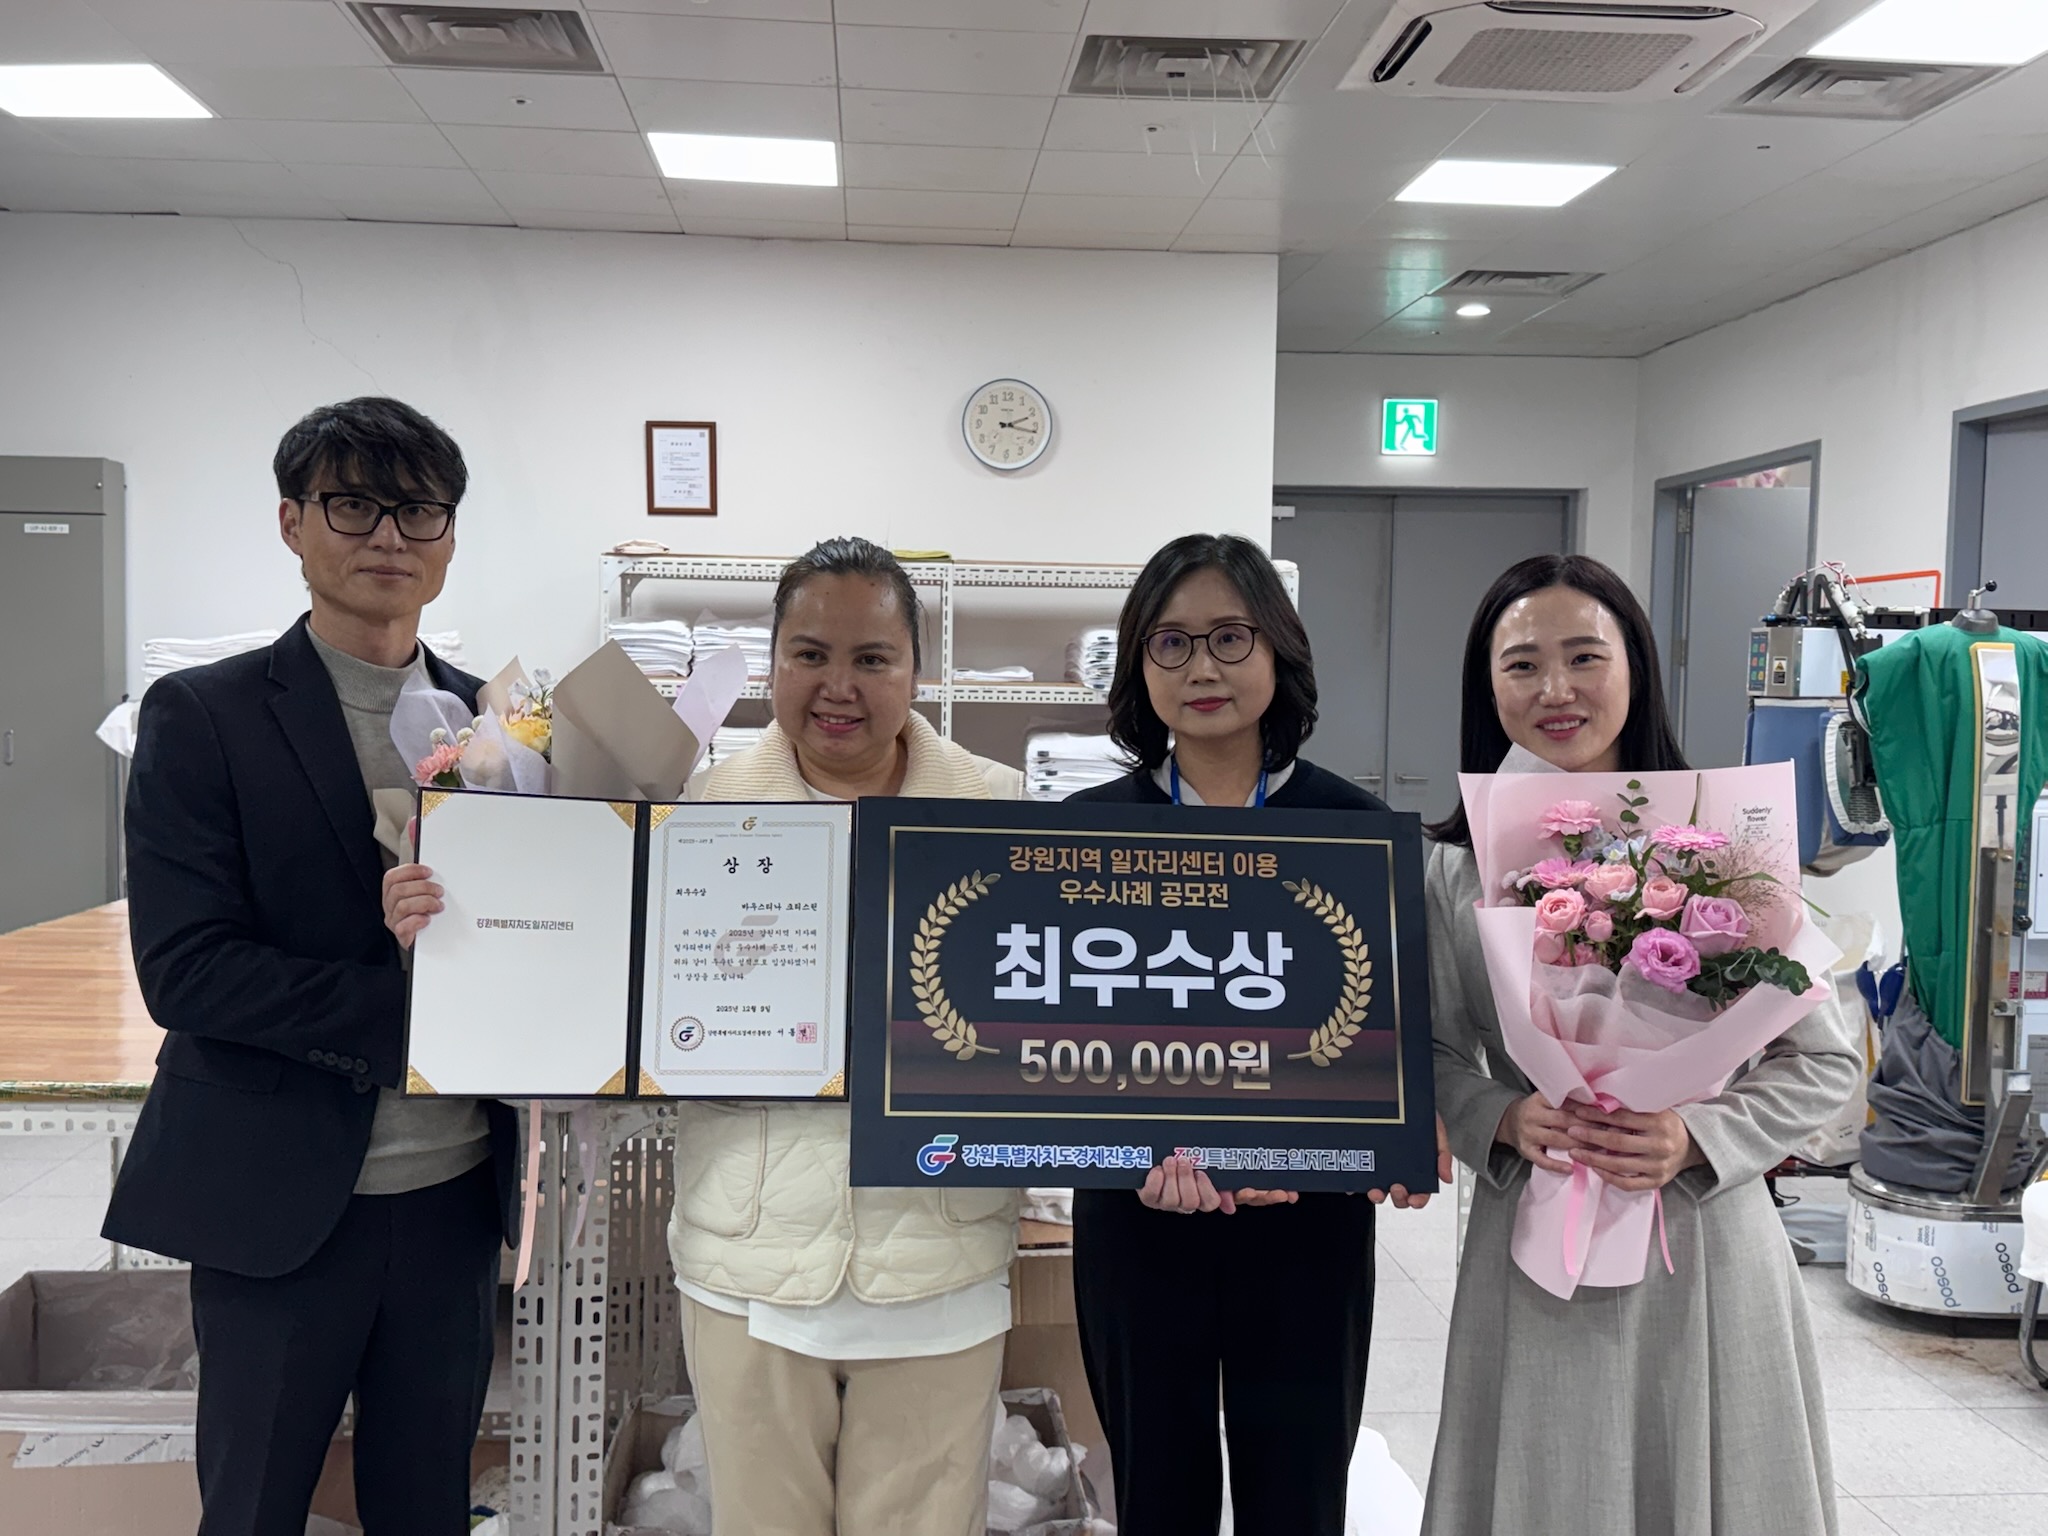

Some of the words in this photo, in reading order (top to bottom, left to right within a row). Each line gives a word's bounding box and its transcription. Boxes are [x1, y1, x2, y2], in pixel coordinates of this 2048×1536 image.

[989, 394, 999, 405] 11
[1002, 392, 1014, 402] 12
[1019, 396, 1024, 406] 1
[978, 404, 988, 414] 10
[1028, 407, 1036, 417] 2
[976, 419, 982, 429] 9
[1032, 422, 1039, 431] 3
[979, 433, 985, 443] 8
[1028, 436, 1035, 446] 4
[988, 445, 996, 455] 7
[1003, 448, 1010, 460] 6
[1017, 446, 1024, 456] 5
[1742, 806, 1772, 815] Suddenly
[723, 856, 739, 874] 상
[757, 856, 773, 874] 장
[1008, 846, 1101, 874] 강원지역
[1110, 850, 1225, 878] 일자리센터
[1232, 853, 1278, 878] 이용
[676, 888, 707, 896] 최우수상
[1059, 880, 1152, 907] 우수사례
[1160, 882, 1230, 908] 공모전
[477, 918, 574, 931] 강원특별자치도일자리센터
[993, 922, 1294, 1010] 최우수상
[1019, 1038, 1272, 1092] 500,000원
[962, 1144, 1152, 1169] 강원특별자치도경제진흥원
[1995, 1242, 2023, 1293] posco
[1931, 1256, 1961, 1308] posco
